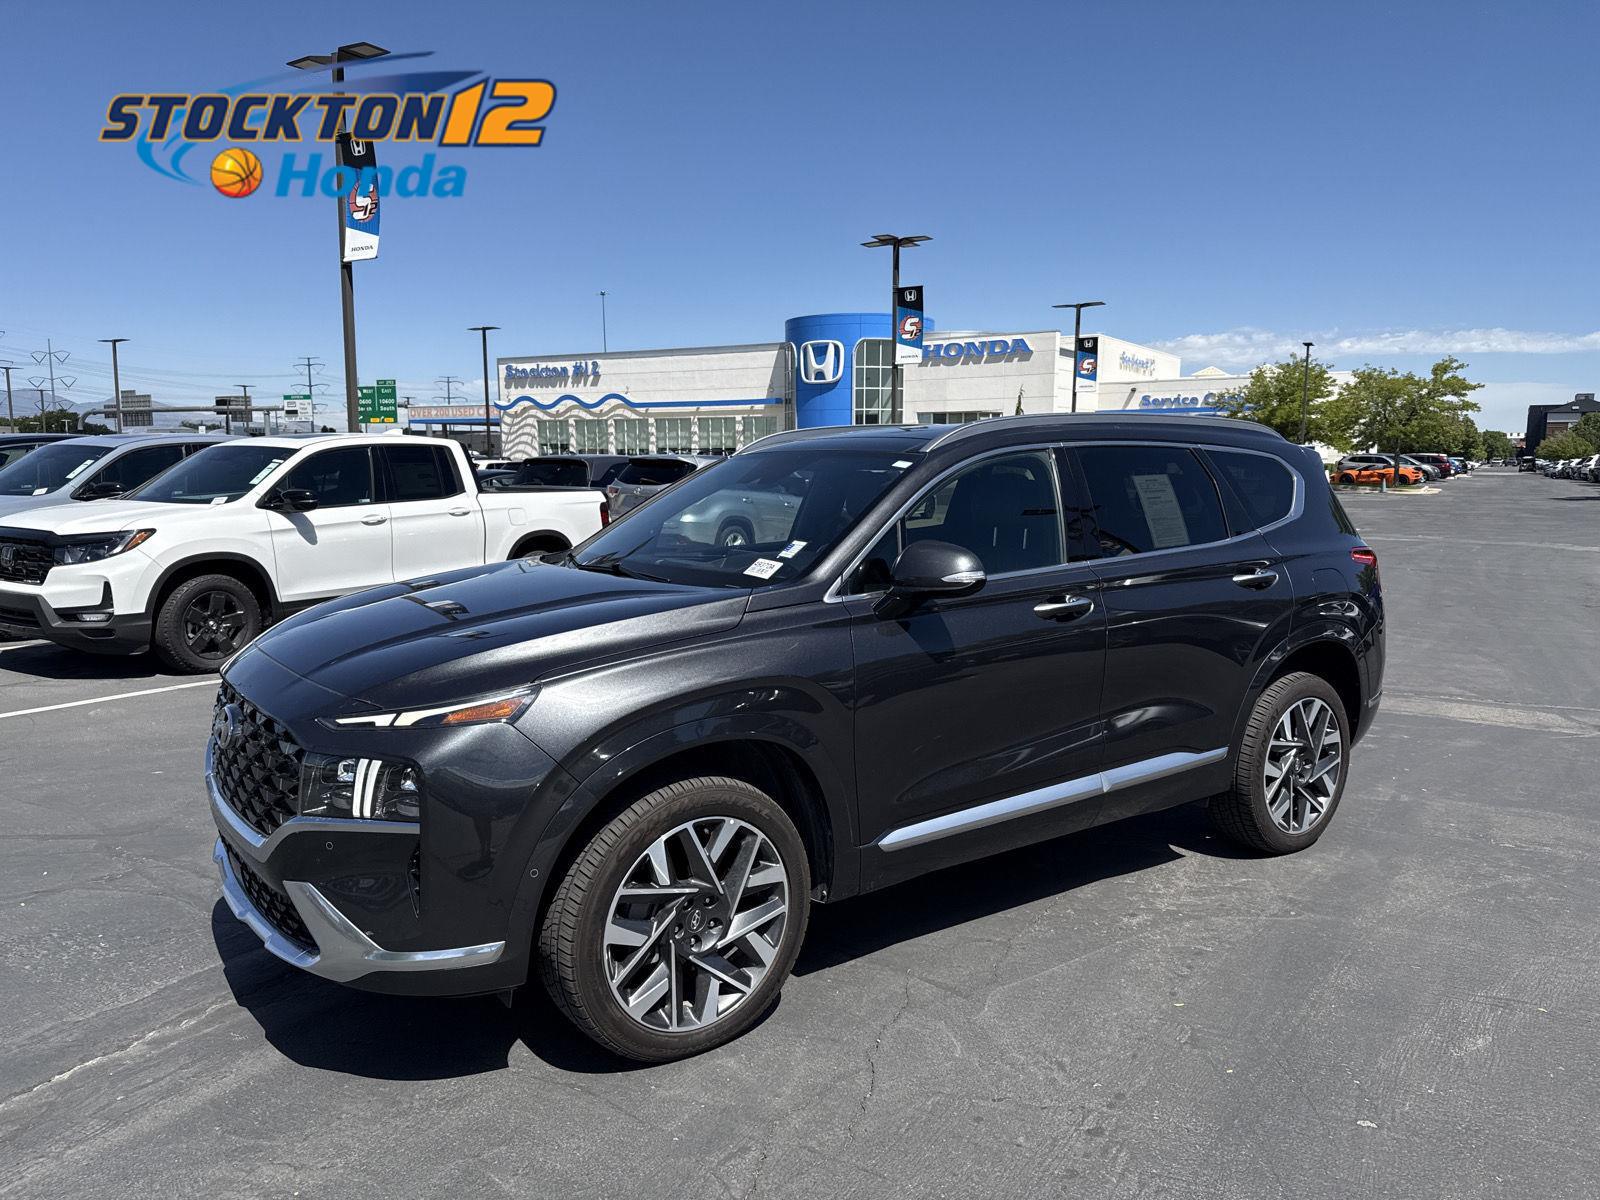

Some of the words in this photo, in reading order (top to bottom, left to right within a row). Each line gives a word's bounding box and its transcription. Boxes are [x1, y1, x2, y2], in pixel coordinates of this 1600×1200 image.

[351, 244, 374, 252] HONDA
[922, 338, 1033, 359] HONDA
[1140, 393, 1199, 408] Service
[410, 407, 433, 418] OVER
[433, 407, 450, 417] 200
[451, 407, 475, 417] USED
